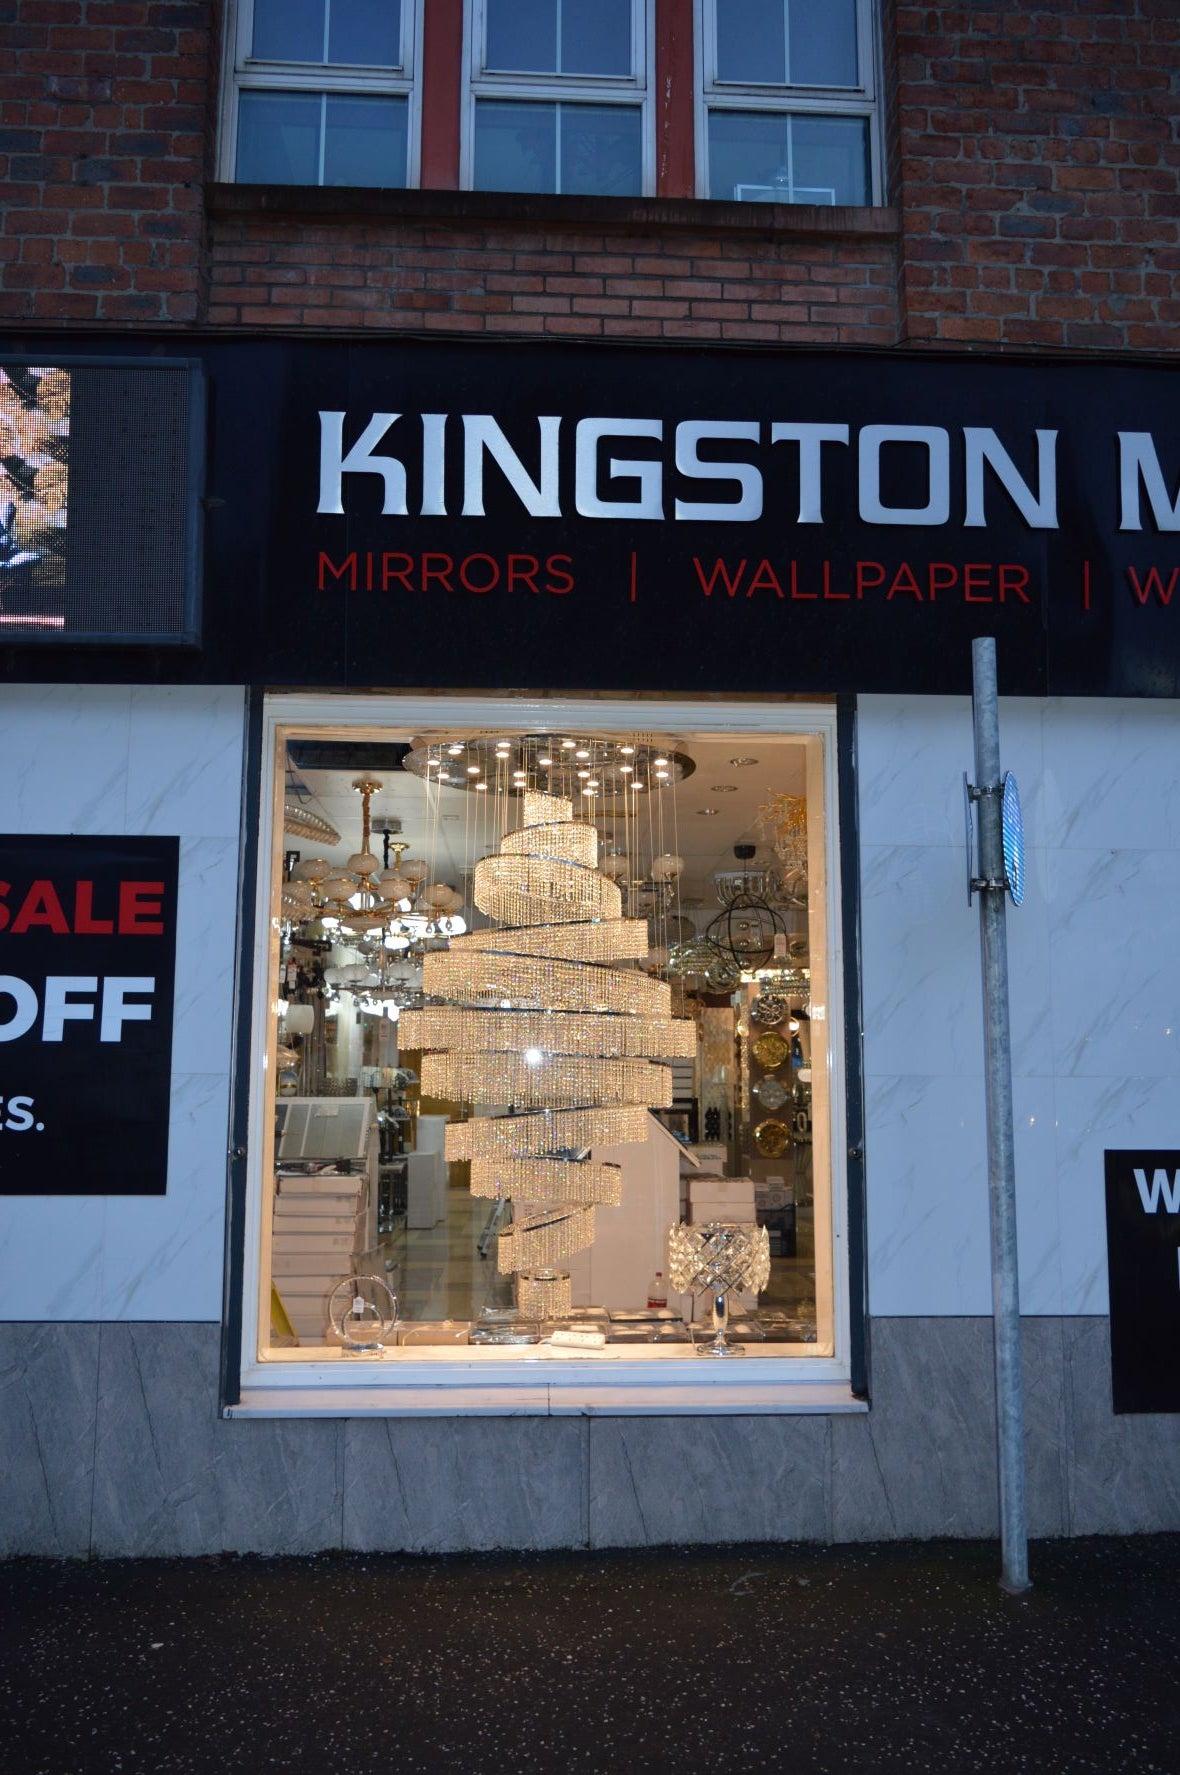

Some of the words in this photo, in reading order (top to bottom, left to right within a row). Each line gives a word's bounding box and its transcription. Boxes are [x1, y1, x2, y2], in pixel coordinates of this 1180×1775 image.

[316, 410, 1060, 530] KINGSTON
[317, 551, 575, 595] MIRRORS
[693, 557, 1030, 604] WALLPAPER
[0, 879, 166, 936] ALE
